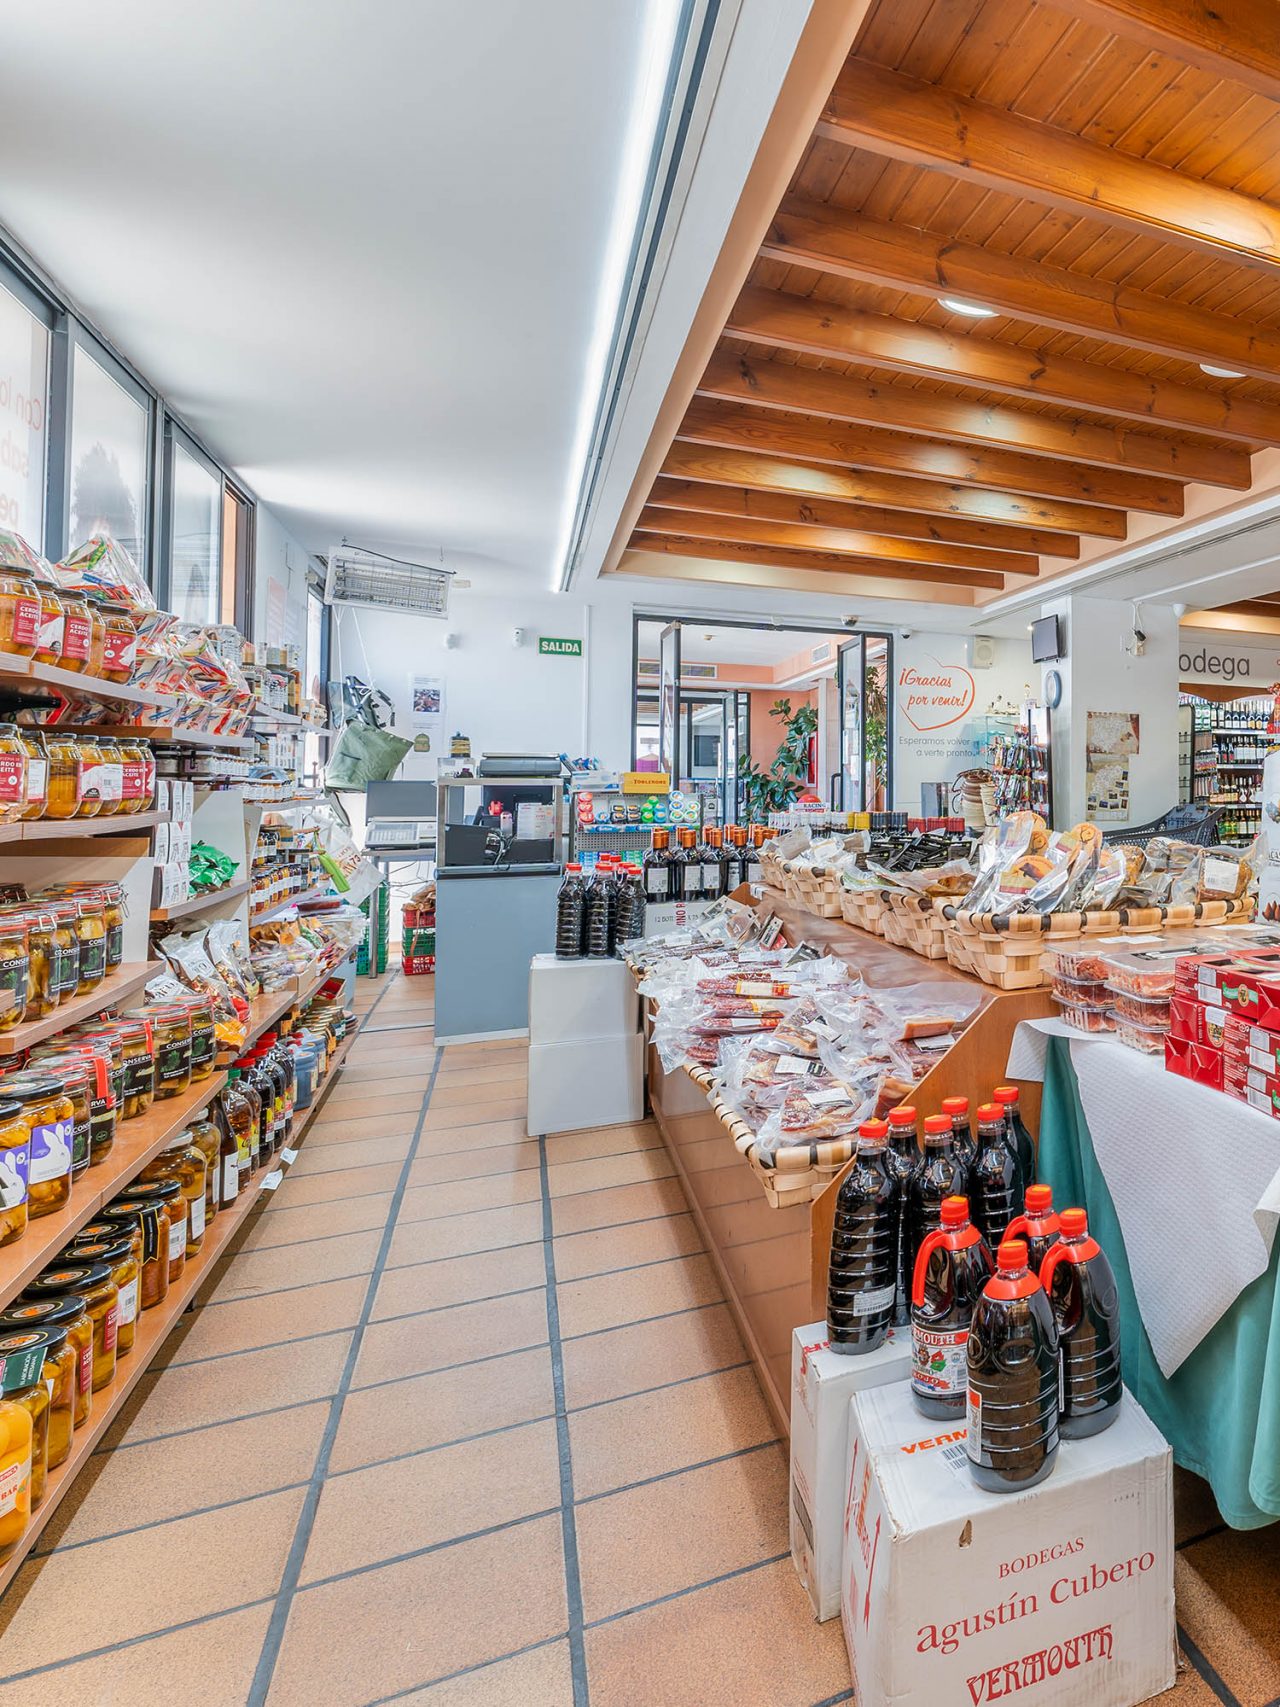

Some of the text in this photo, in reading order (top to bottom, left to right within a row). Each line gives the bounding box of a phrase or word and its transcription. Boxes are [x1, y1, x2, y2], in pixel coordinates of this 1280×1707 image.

[541, 641, 580, 653] SALIDA
[1178, 648, 1250, 681] odega
[907, 688, 968, 710] por venir!
[899, 736, 971, 747] Esperamos volver
[916, 749, 922, 757] a
[924, 749, 945, 757] verte
[998, 1536, 1086, 1579] BODEGAS
[1049, 1552, 1155, 1605] Cubero
[966, 1624, 1113, 1707] VERMOUTH
